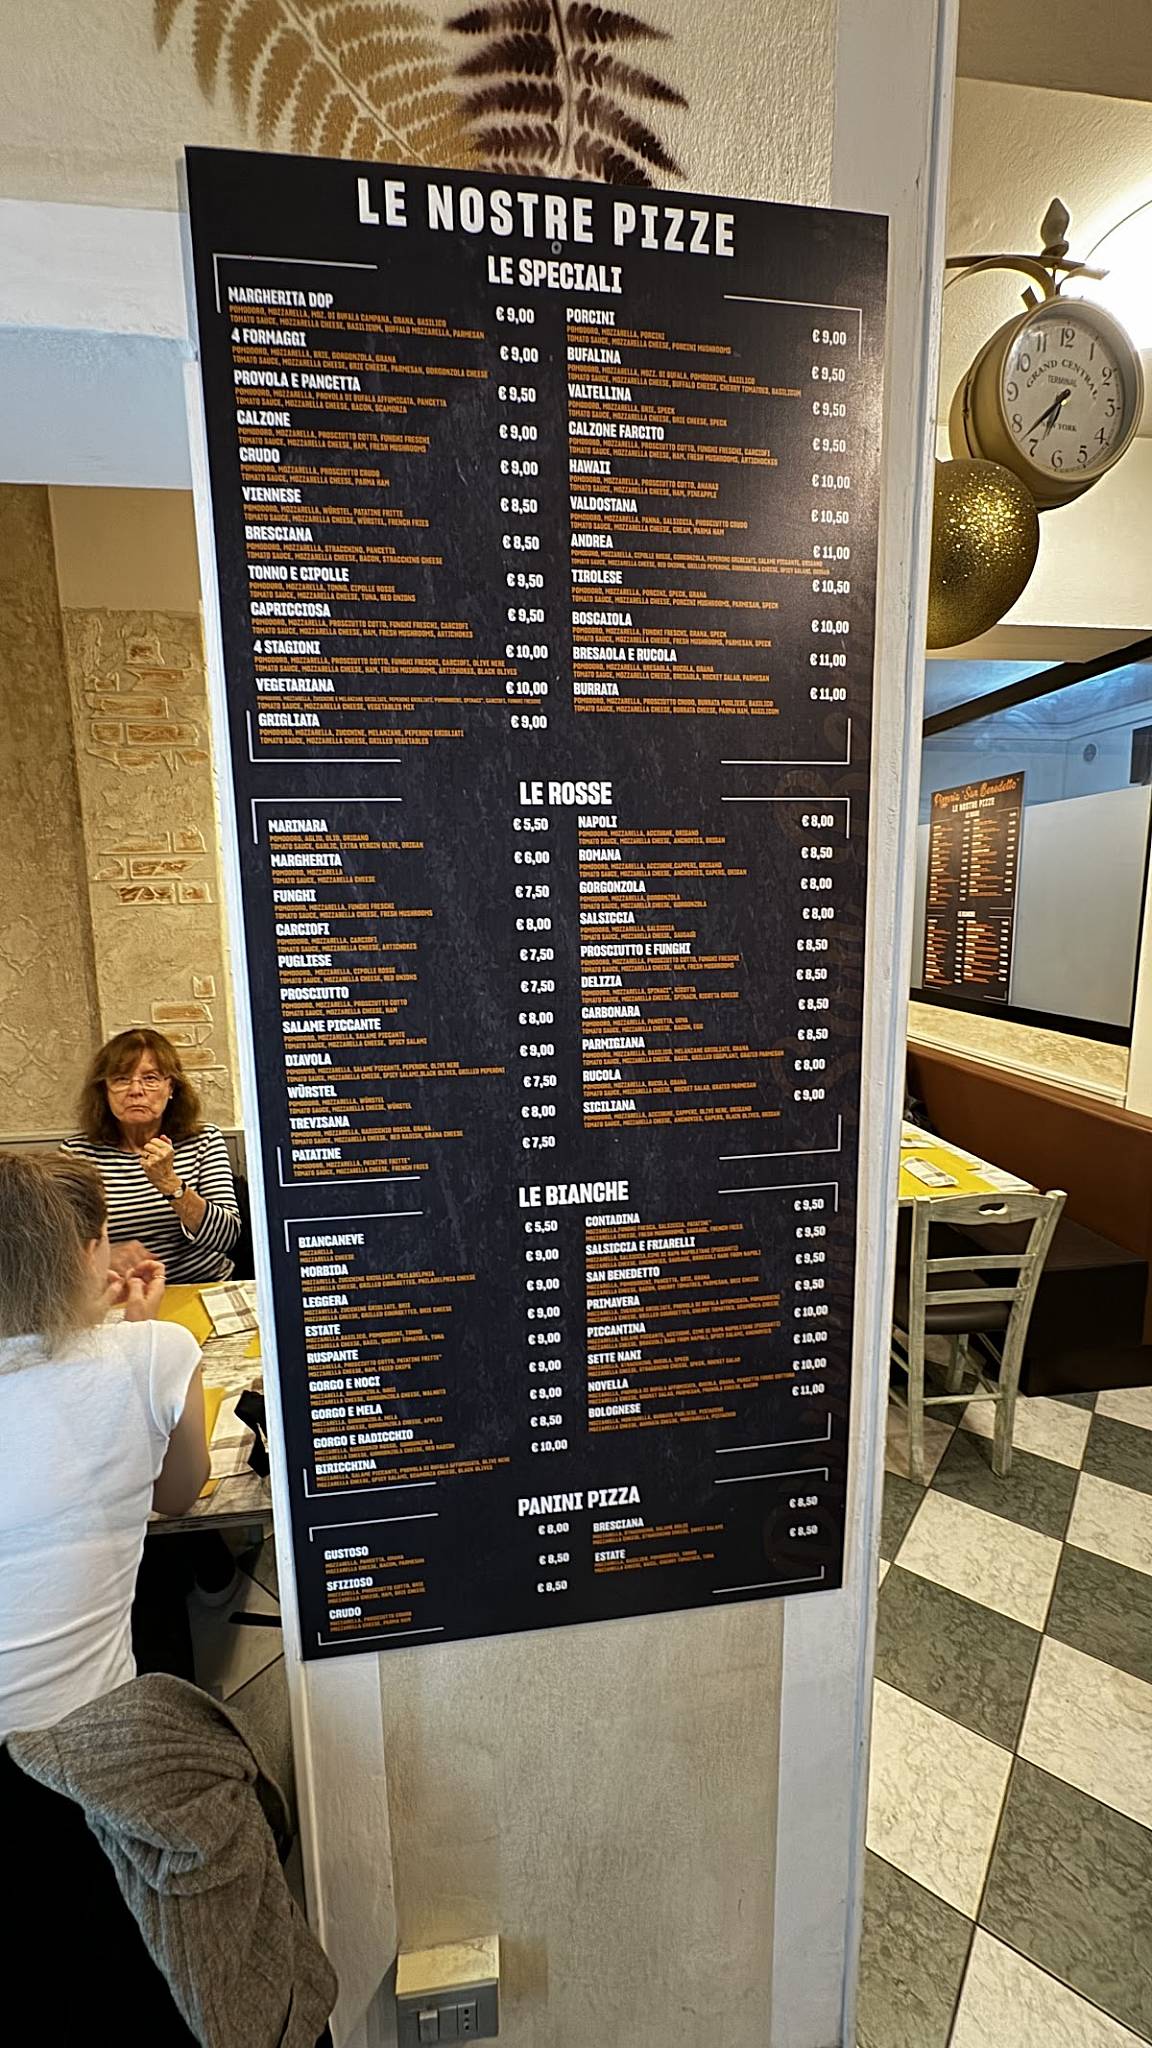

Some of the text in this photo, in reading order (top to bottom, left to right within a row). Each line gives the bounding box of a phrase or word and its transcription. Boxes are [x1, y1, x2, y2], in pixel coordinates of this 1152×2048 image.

[358, 178, 734, 257] LE NOSTRE PIZZE
[488, 255, 622, 294] LE SPECIALI
[228, 286, 333, 308] MARGHERITA DOP
[507, 307, 534, 324] 9,00
[566, 308, 615, 326] PORCINI
[231, 327, 306, 347] 4 FORMAGGI
[822, 330, 847, 346] 9,00
[1036, 333, 1048, 353] 11
[1060, 327, 1076, 348] 12
[567, 346, 621, 364] BUFALINA
[1089, 342, 1095, 361] 1
[1017, 353, 1031, 373] 10
[234, 369, 361, 391] PROVOLA E PANCETTA
[1027, 360, 1057, 388] GRAND
[1102, 366, 1112, 386] 2
[509, 386, 536, 403] 9,50
[568, 383, 632, 401] VALTELLINA
[1006, 381, 1019, 402] 9
[1104, 398, 1115, 417] 3
[237, 410, 291, 427] CALZONE
[1012, 413, 1023, 433] 8
[568, 421, 664, 440] CALZONE FARCITO
[1094, 426, 1107, 445] 4
[239, 447, 280, 463] CRUDO
[1028, 438, 1039, 457] 7
[1077, 444, 1088, 464] 5
[1051, 450, 1063, 468] 6
[569, 459, 611, 475] HAWAII
[821, 475, 852, 490] 10,00
[242, 486, 302, 503] VIENNESE
[570, 496, 637, 513] VALDOSTANA
[245, 525, 313, 542] BRESCIANA
[571, 533, 613, 548] ANDREA
[822, 546, 850, 561] 11,00
[247, 565, 349, 582] TONNO E CIPOLLE
[571, 569, 622, 584] TIROLESE
[250, 602, 331, 617] CAPRICCIOSA
[572, 611, 632, 626] BOSCAIOLA
[253, 640, 321, 655] 4 STAGIONI
[516, 645, 548, 660] 10,00
[573, 646, 677, 662] BRESAOLA E RUCOLA
[255, 678, 335, 692] VEGETARIANA
[573, 682, 619, 696] BURRATA
[258, 713, 320, 727] GRIGLIATA
[520, 781, 612, 805] LE ROSSE
[268, 819, 328, 833] MARINARA
[523, 818, 549, 832] 5,50
[578, 815, 617, 828] NAPOLI
[811, 815, 834, 828] 8,00
[270, 853, 342, 867] MARGHERITA
[579, 849, 622, 861] ROMANA
[579, 880, 646, 893] GORGONZOLA
[273, 889, 317, 903] FUNGHI
[580, 911, 635, 925] SALSICCIA
[276, 923, 330, 936] CARCIOFI
[580, 942, 691, 957] PROSCIUTTO E FUNGHI
[278, 954, 332, 968] PUGLIESE
[581, 975, 622, 988] DELIZIA
[280, 986, 349, 1001] PROSCIUTTO
[581, 1005, 641, 1019] CARBONARA
[282, 1018, 381, 1033] SALAME PICCANTE
[582, 1036, 645, 1050] PARMIGIANA
[285, 1053, 332, 1067] DIAVOLA
[583, 1069, 622, 1082] RUCOLA
[287, 1084, 337, 1098] WÜRSTEL
[583, 1099, 636, 1113] SICILIANA
[289, 1115, 350, 1129] TREVISANA
[292, 1147, 342, 1162] PATATINE
[519, 1180, 629, 1207] LE BIANCHE
[585, 1213, 640, 1227] CONTADINA
[298, 1233, 365, 1248] BIANCANEVE
[585, 1236, 695, 1255] SALSICCIA E FRIARELLI
[300, 1264, 349, 1278] MORBIDA
[586, 1266, 660, 1283] SAN BENEDETTO
[303, 1294, 349, 1308] LEGGERA
[587, 1295, 640, 1310] PRIMAVERA
[305, 1324, 341, 1337] ESTATE
[587, 1322, 646, 1338] PICCANTINA
[307, 1349, 359, 1364] RUSPANTE
[587, 1350, 642, 1365] SETTE NANI
[309, 1376, 380, 1392] GORGO E NOCI
[588, 1378, 629, 1392] NOVELLA
[311, 1404, 383, 1420] GORGO E MELA
[588, 1403, 641, 1418] BOLOGNESE
[313, 1429, 413, 1449] GORGO E RADICCHIO
[315, 1458, 377, 1475] BIRICCHINA
[518, 1486, 640, 1516] PANINI PIZZA
[797, 1496, 818, 1507] 8,50
[593, 1517, 644, 1532] BRESCIANA
[324, 1546, 369, 1562] GUSTOSO
[595, 1549, 625, 1562] ESTATE
[326, 1577, 373, 1592] SFIZIOSO
[329, 1606, 361, 1620] CRUDO
